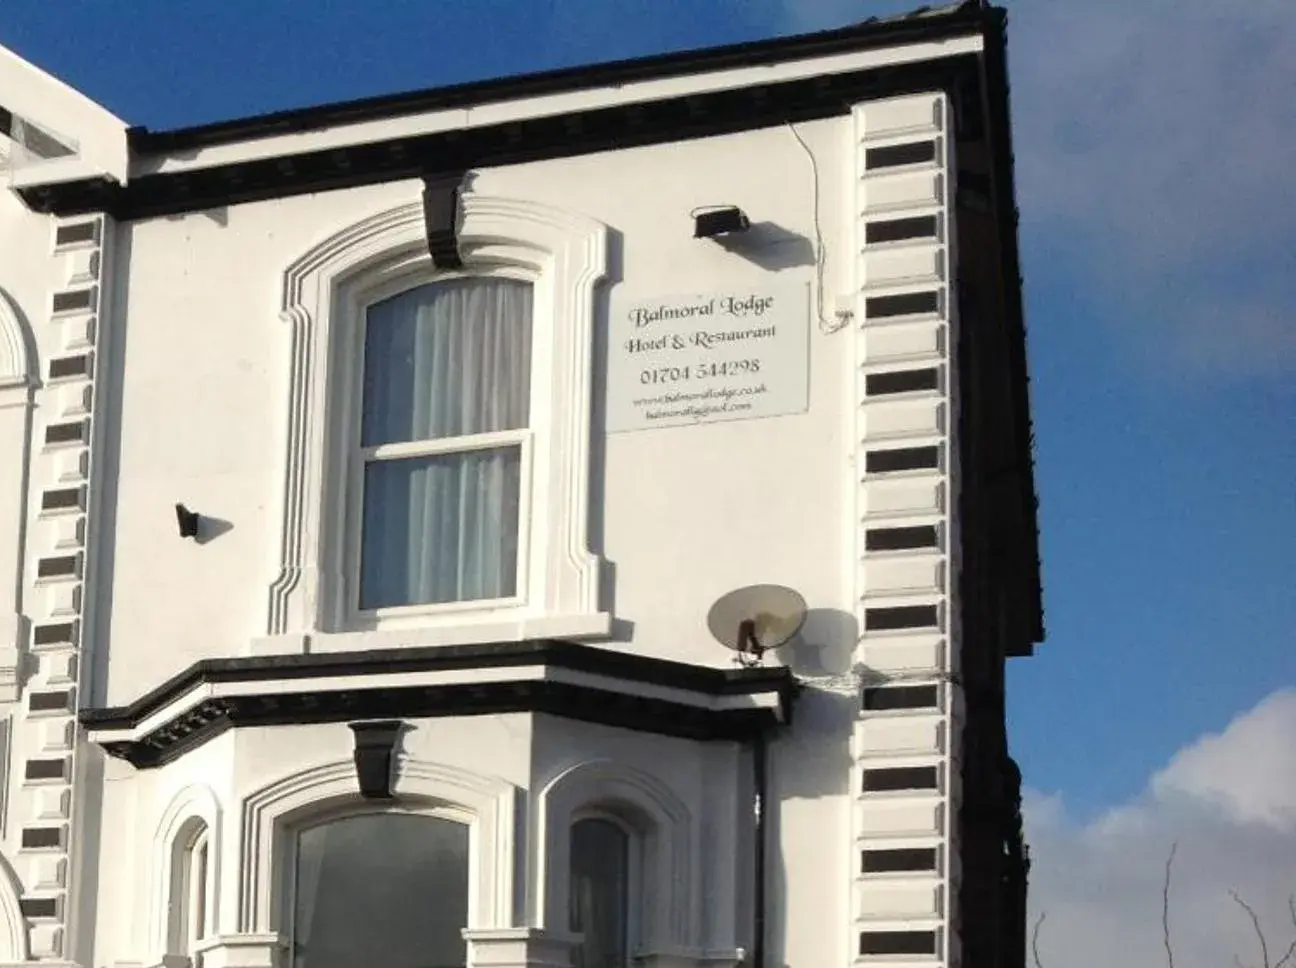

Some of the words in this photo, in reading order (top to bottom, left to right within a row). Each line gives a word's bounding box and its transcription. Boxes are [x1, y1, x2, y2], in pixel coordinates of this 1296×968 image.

[628, 300, 714, 327] Balmoral
[720, 295, 774, 316] Lodge
[624, 333, 667, 353] Hotel
[671, 334, 687, 350] &
[689, 326, 776, 349] Restaurant
[640, 365, 689, 384] 01704
[695, 358, 760, 379] 544298
